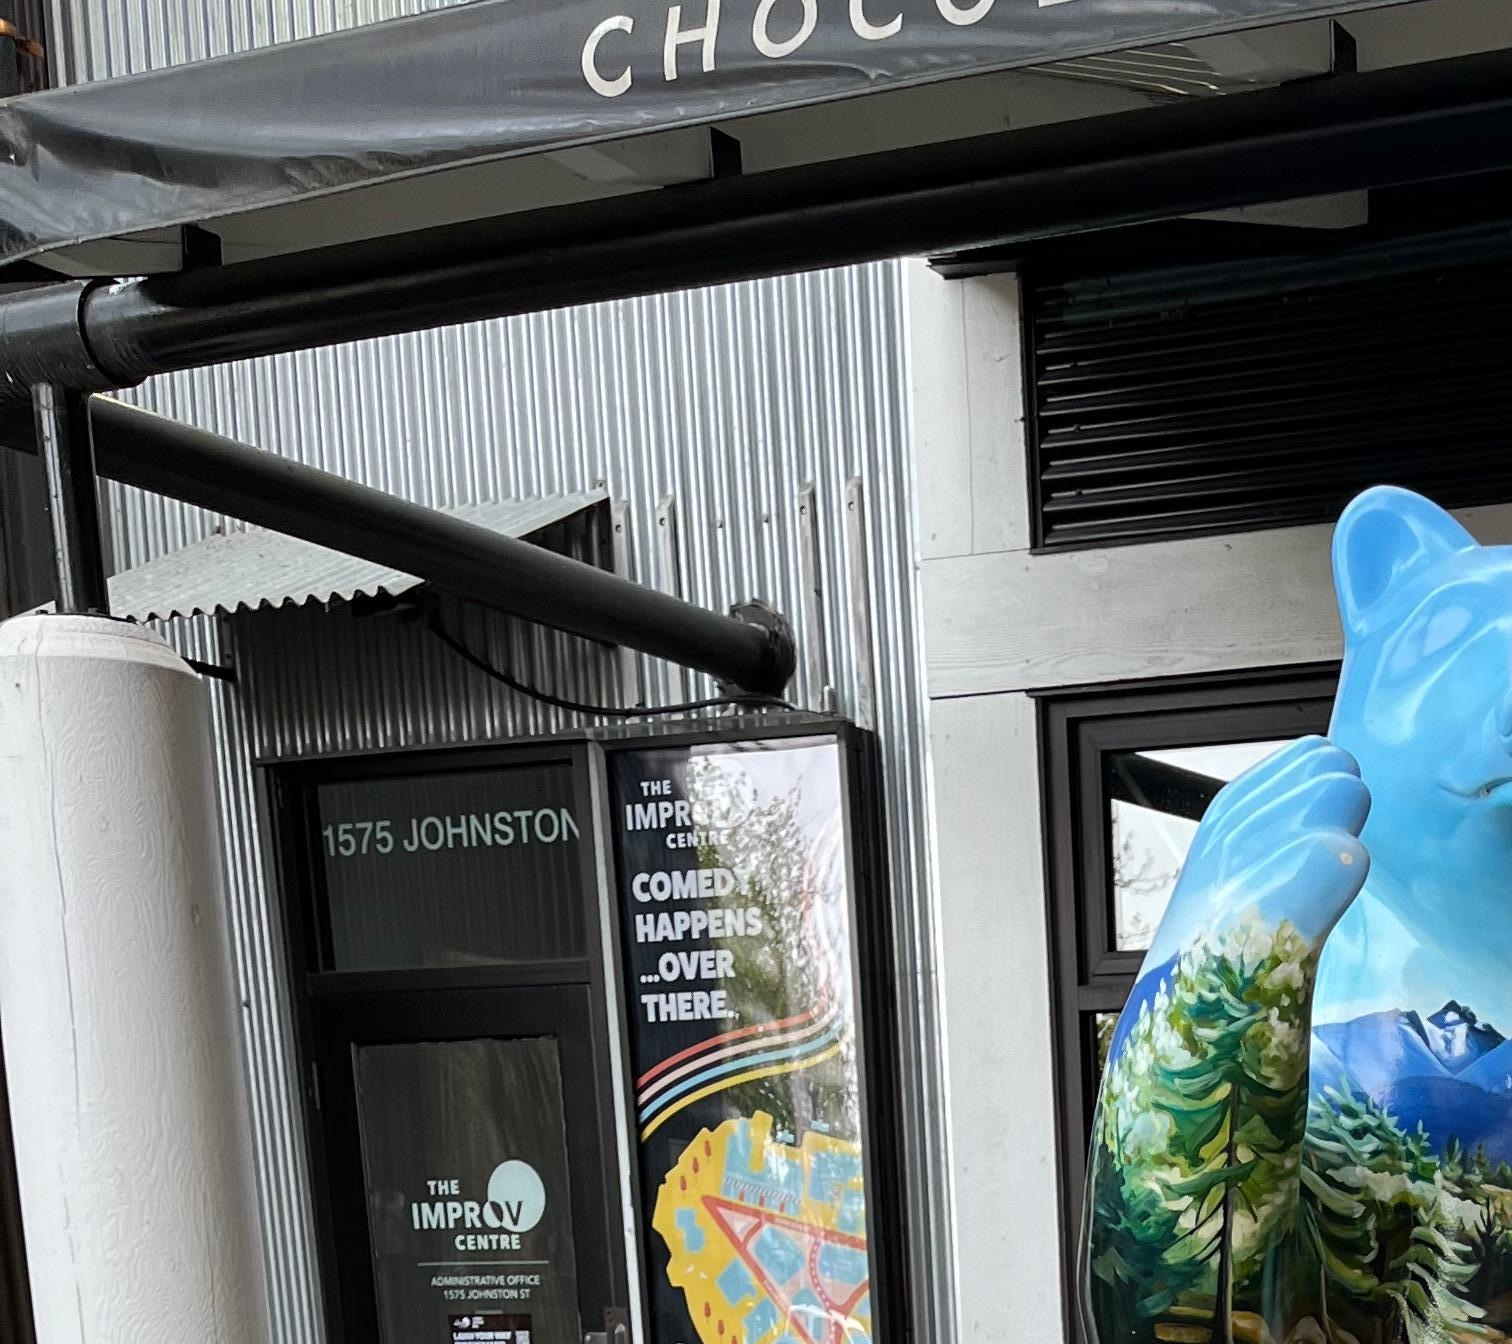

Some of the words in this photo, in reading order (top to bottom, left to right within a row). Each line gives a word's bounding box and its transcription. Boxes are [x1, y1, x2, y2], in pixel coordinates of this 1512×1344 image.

[640, 779, 672, 797] THE
[322, 820, 394, 857] 1575
[403, 807, 580, 852] JOHNSTON
[666, 830, 729, 849] CENTRE
[632, 866, 750, 902] COMEDY
[635, 906, 762, 943] HAPPENS
[640, 949, 735, 984] ...OVER
[427, 1179, 460, 1196] THE
[411, 1200, 523, 1230] IMPROV
[455, 1234, 522, 1251] CENTRE
[431, 1276, 505, 1287] ADMINISTRATIVE
[506, 1275, 541, 1286] OFFICE
[443, 1289, 465, 1300] 1575
[467, 1288, 518, 1300] JOHNSTON
[519, 1288, 531, 1299] ST
